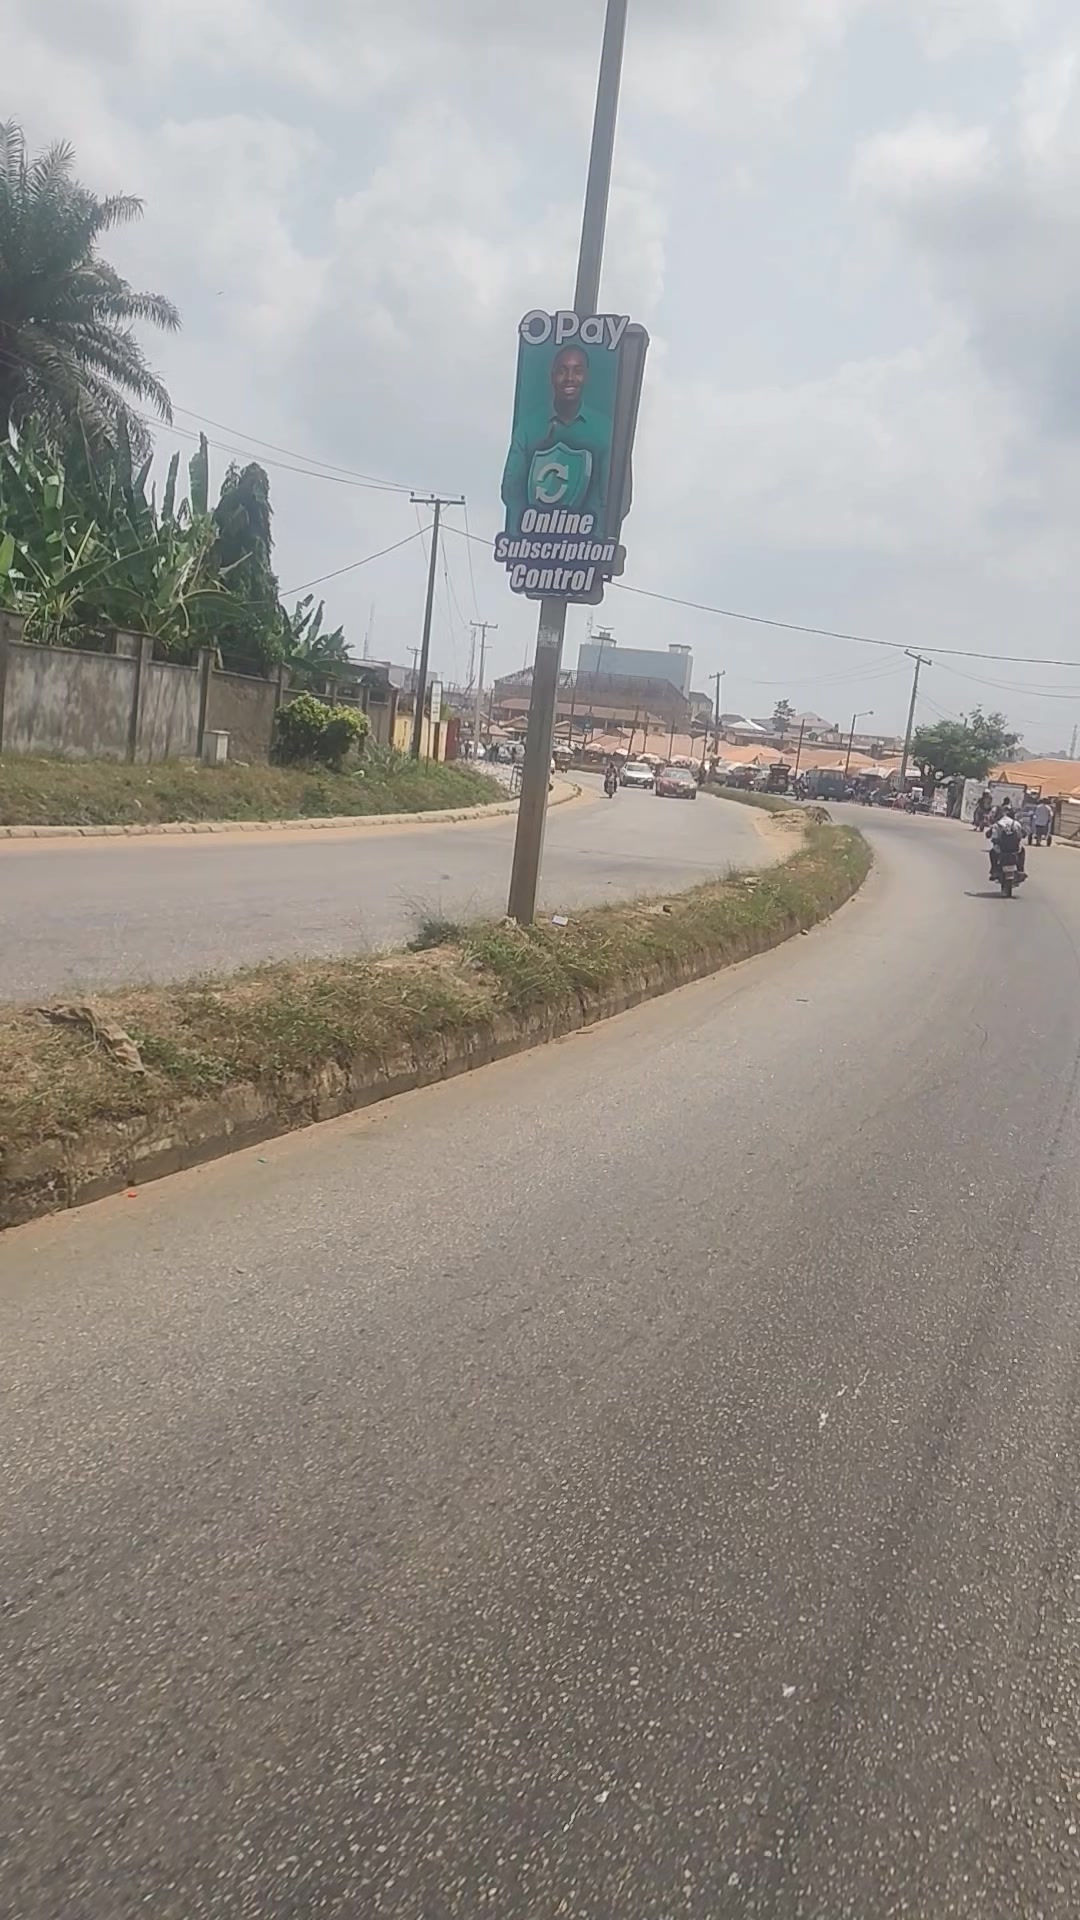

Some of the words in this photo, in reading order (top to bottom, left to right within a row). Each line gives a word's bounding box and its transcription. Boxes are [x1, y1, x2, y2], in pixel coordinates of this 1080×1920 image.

[521, 310, 629, 349] OPay
[521, 509, 594, 535] Online
[496, 538, 615, 562] Subscription
[510, 563, 595, 591] Control
